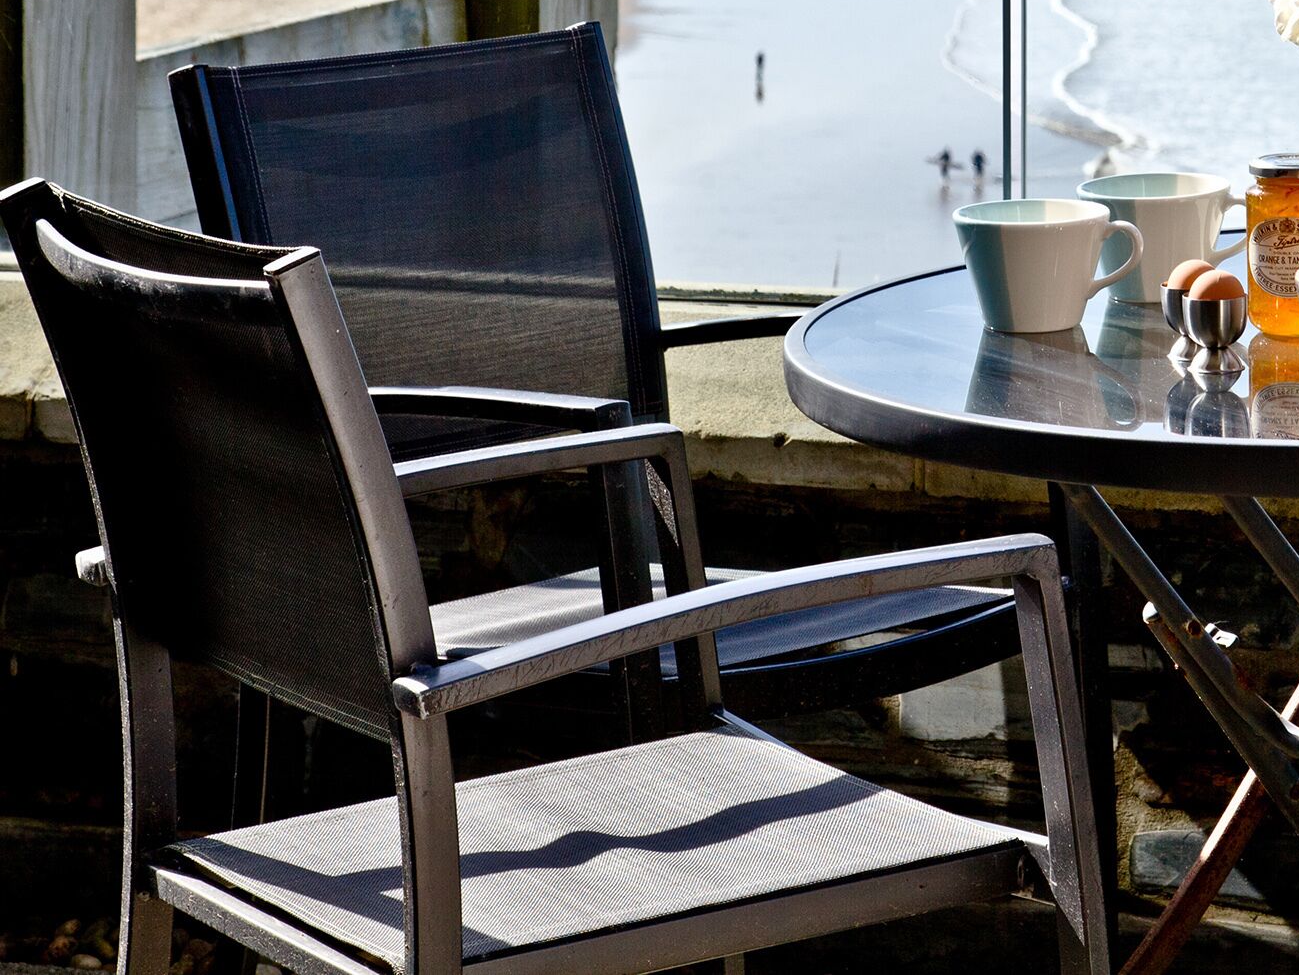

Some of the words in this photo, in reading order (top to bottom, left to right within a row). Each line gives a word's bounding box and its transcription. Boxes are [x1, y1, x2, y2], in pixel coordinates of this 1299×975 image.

[1272, 223, 1278, 231] &
[1258, 254, 1280, 264] ORANGE
[1280, 256, 1286, 264] &
